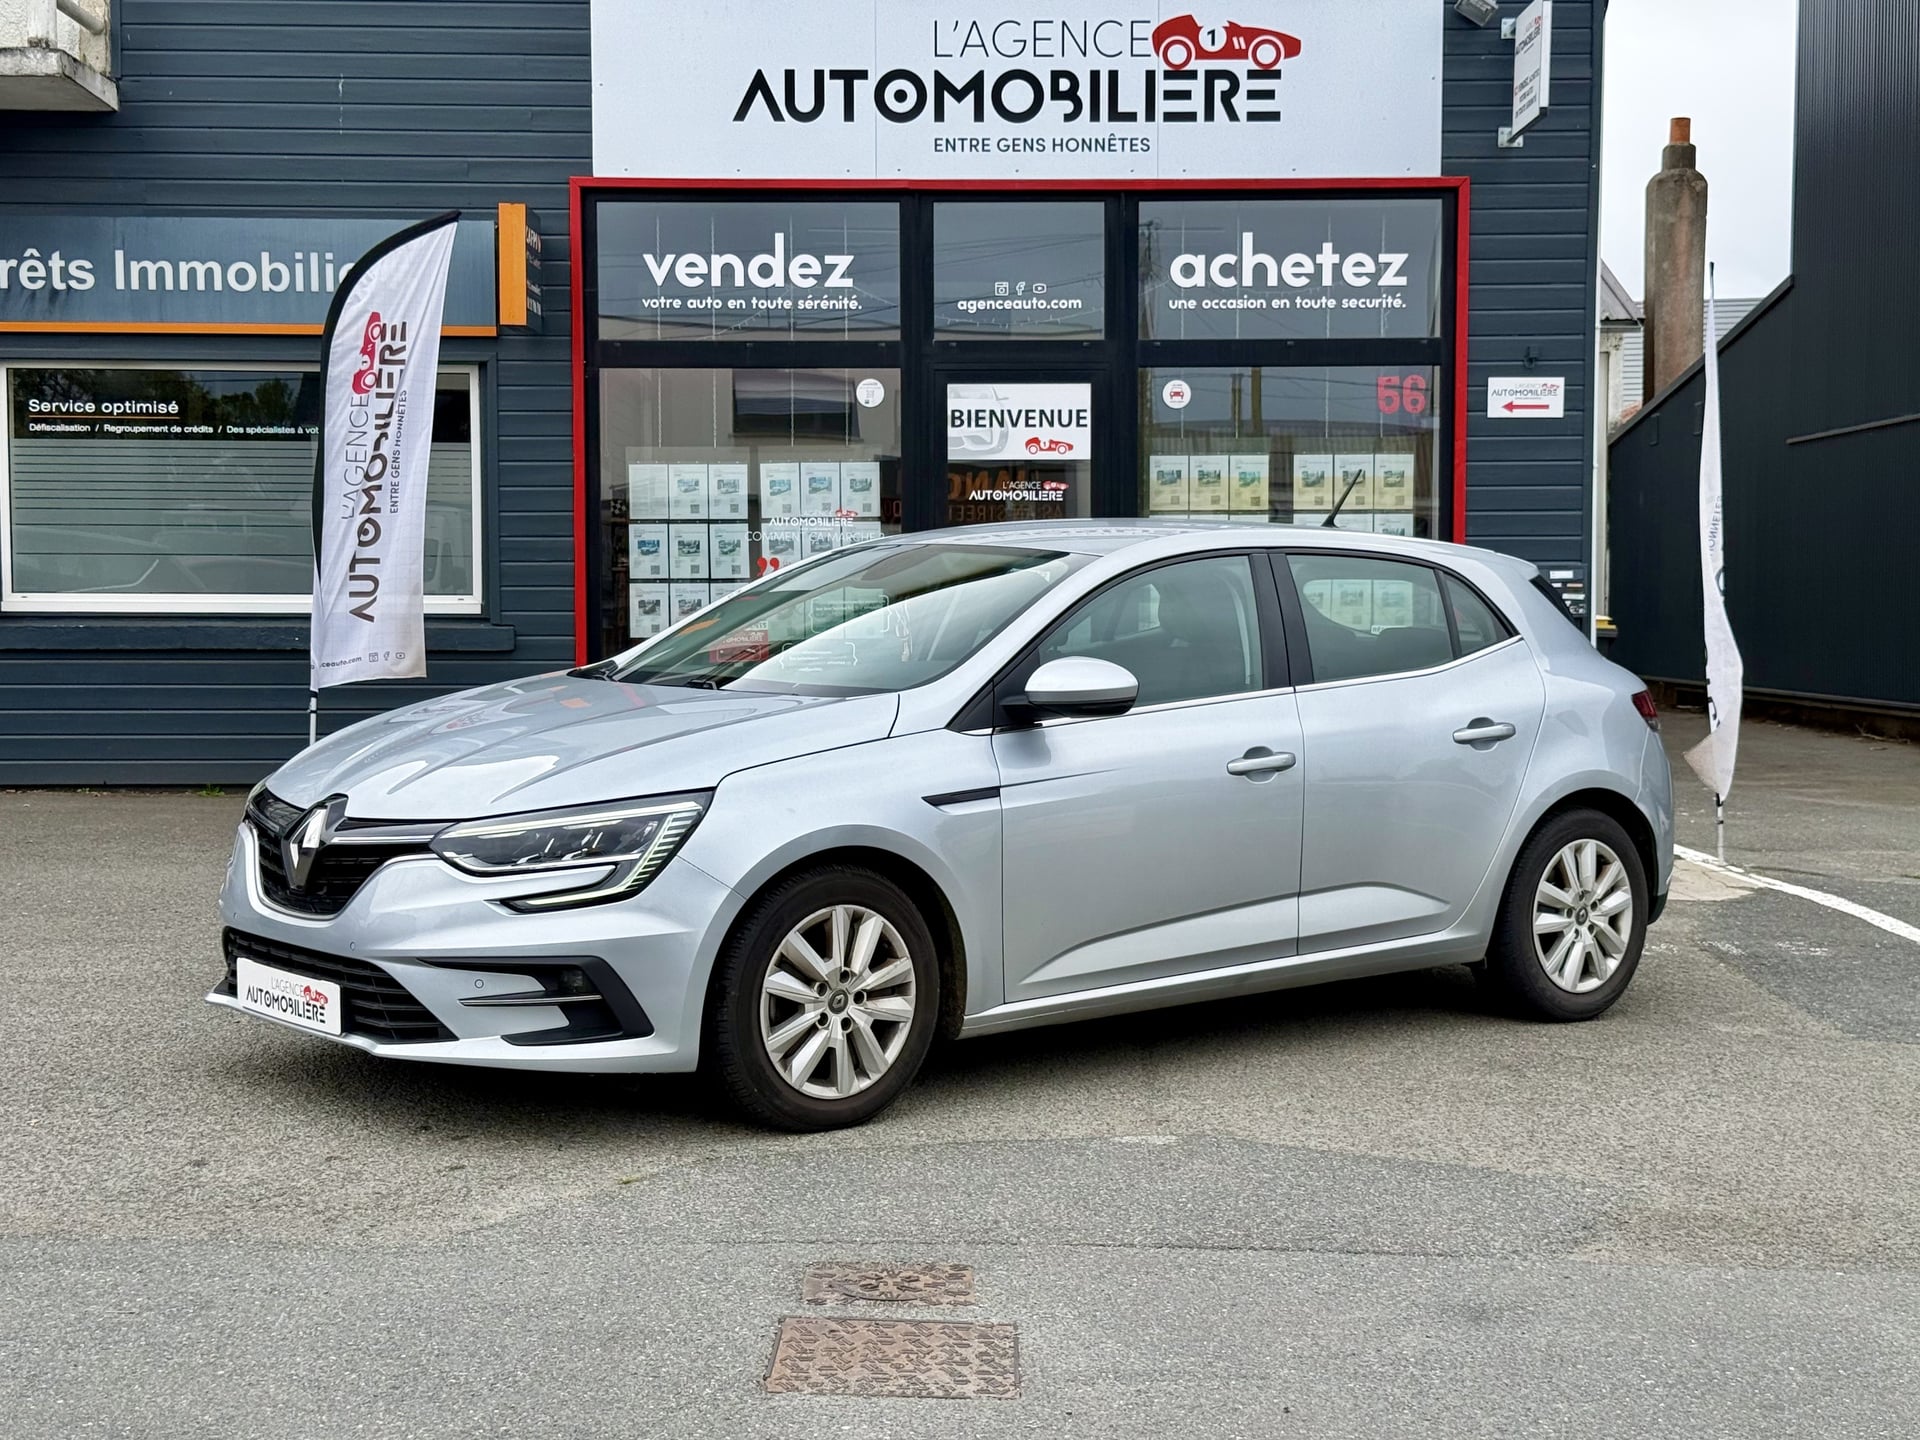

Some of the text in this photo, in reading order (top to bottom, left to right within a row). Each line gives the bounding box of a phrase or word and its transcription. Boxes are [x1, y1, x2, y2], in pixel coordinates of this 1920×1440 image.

[933, 20, 1152, 58] L'AGENCE
[934, 134, 1151, 152] ENTRE GENS HONNÊTES
[642, 232, 854, 288] vendez
[1170, 232, 1409, 288] achetez
[642, 294, 862, 310] votre auto en toute sérénité.
[957, 297, 1082, 314] agenceauto.com
[1169, 293, 1406, 309] une occasion en toute securité.
[1377, 374, 1427, 414] 56
[29, 399, 179, 416] Service optimisé
[950, 409, 1088, 428] BIENVENUE
[29, 423, 91, 433] Défiscalisation
[104, 425, 169, 434] Regroupement
[170, 425, 182, 433] de
[184, 425, 214, 434] crédits
[226, 425, 245, 434] Des
[246, 426, 296, 435] spécialistes
[392, 449, 401, 478] GENS
[1003, 481, 1041, 489] L'AGENCE
[390, 481, 399, 514] ENTRE
[969, 490, 1063, 501] AUTOMOBILIERE
[744, 531, 805, 542] COMMENT
[320, 656, 362, 669] ceauto.com
[271, 976, 304, 998] L'AGENCE
[246, 984, 326, 1024] AUTOMOBILIERE
